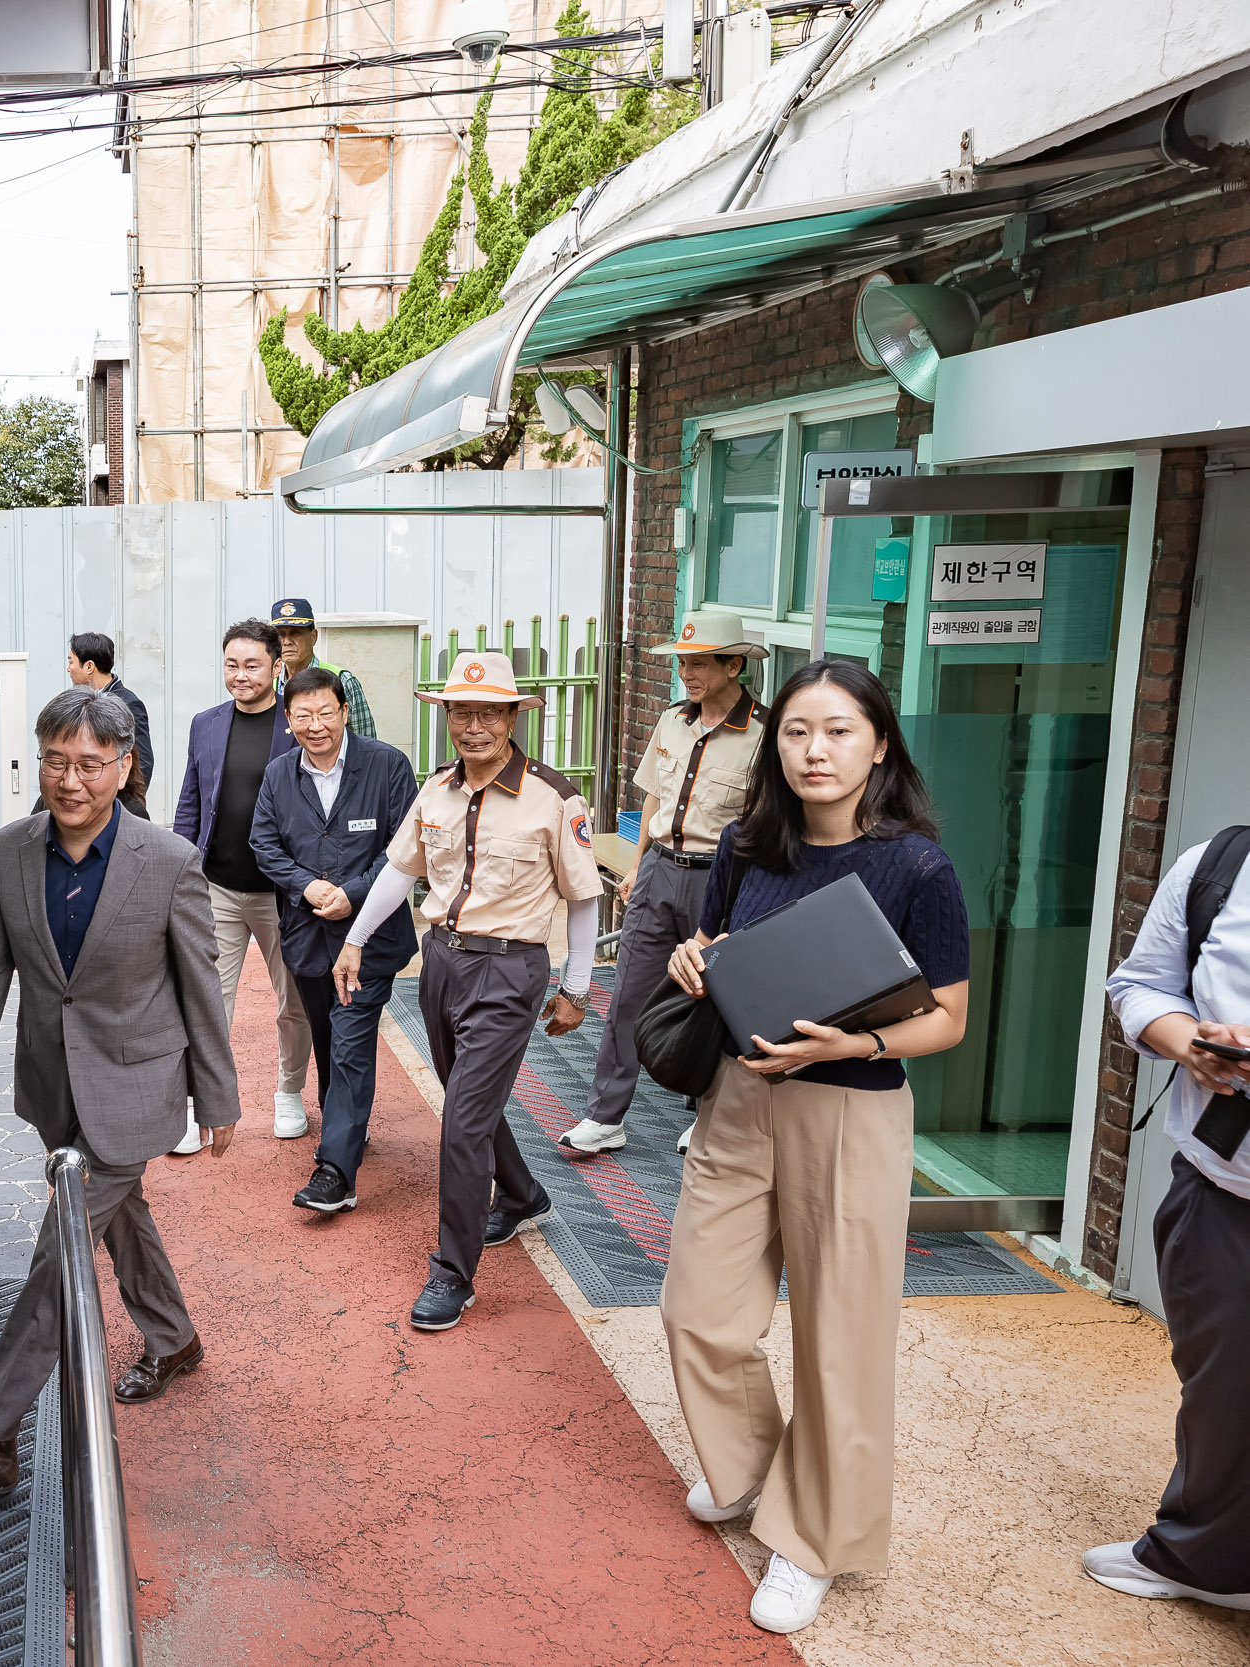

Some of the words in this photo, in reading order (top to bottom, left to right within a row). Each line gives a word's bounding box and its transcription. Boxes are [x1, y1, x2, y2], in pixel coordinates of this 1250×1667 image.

[940, 560, 1036, 584] 제한구역
[932, 621, 979, 635] 관계직원외
[984, 620, 1013, 633] 출입을
[1017, 619, 1037, 633] 금함
